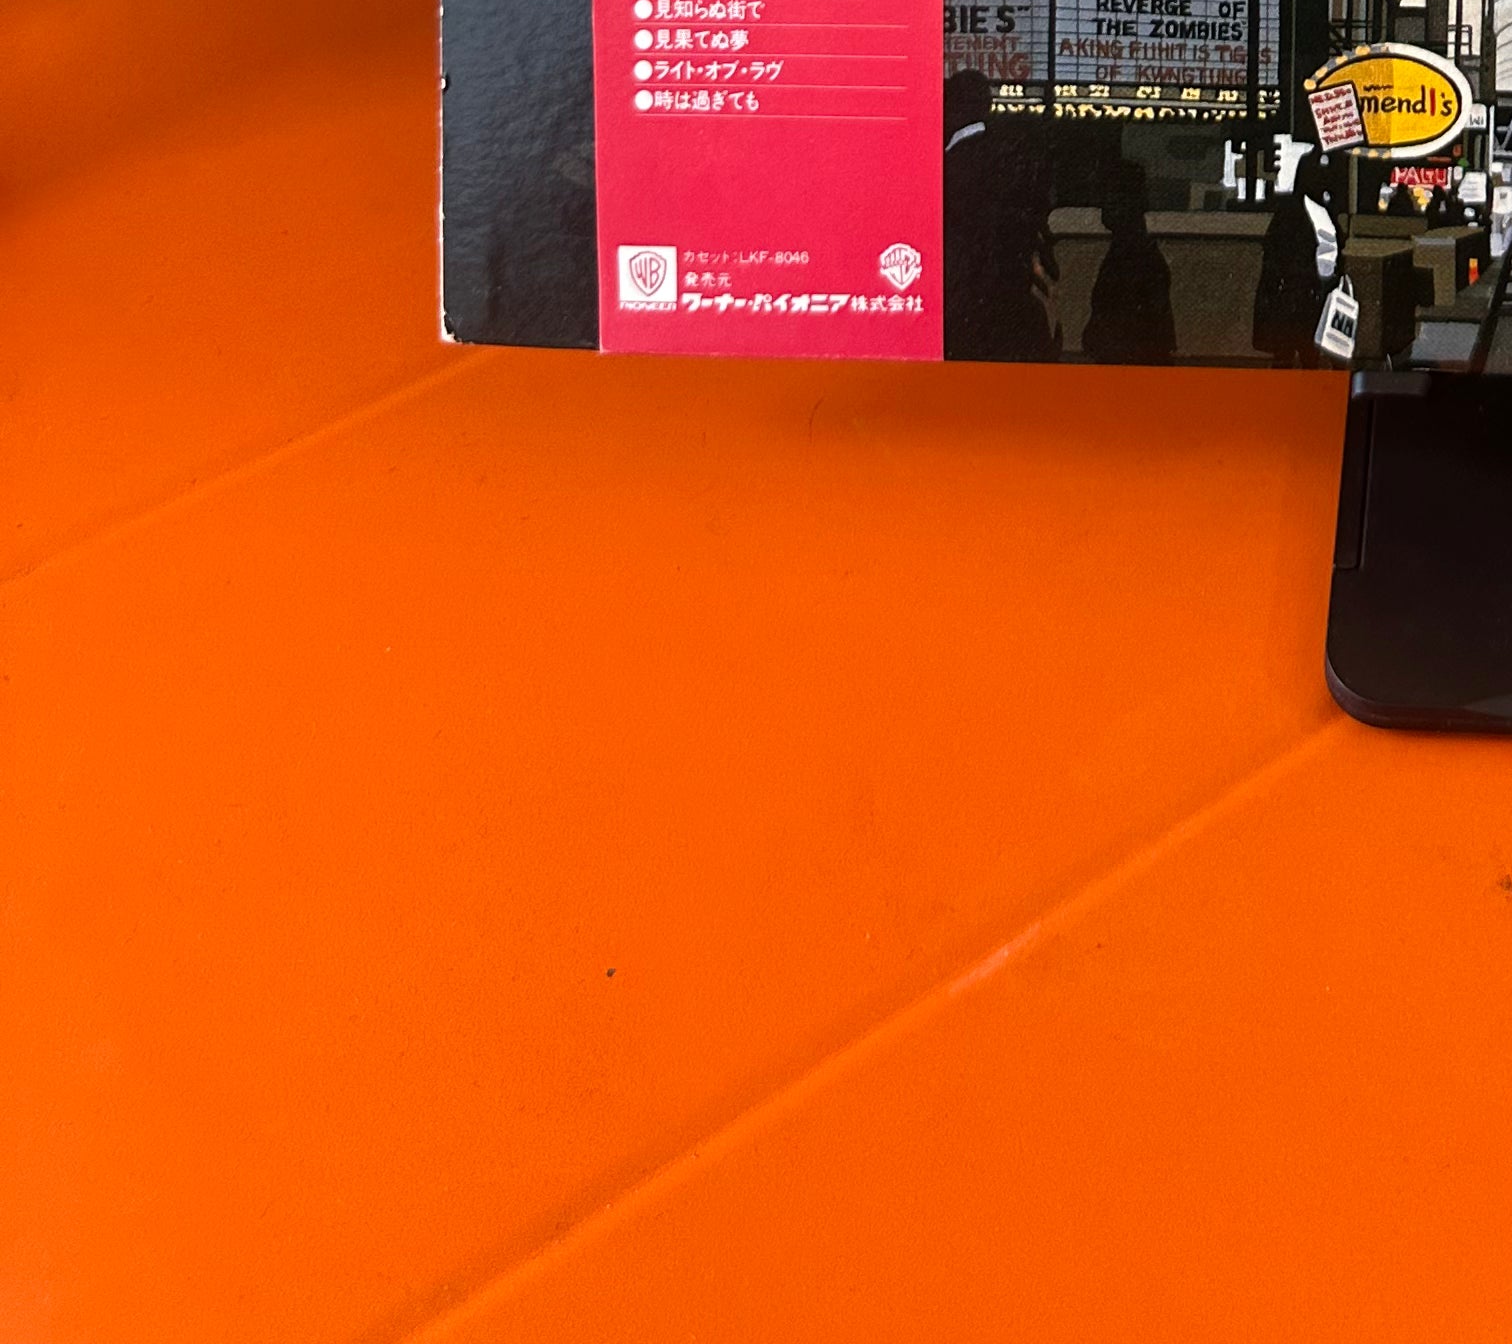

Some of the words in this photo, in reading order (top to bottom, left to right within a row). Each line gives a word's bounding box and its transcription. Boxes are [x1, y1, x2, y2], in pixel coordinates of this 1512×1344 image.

[1217, 0, 1247, 20] OF
[1092, 17, 1138, 37] THE
[654, 28, 750, 51] 見果てぬ夢
[653, 89, 761, 113] 時は過ぎても
[684, 271, 733, 288] 発売元
